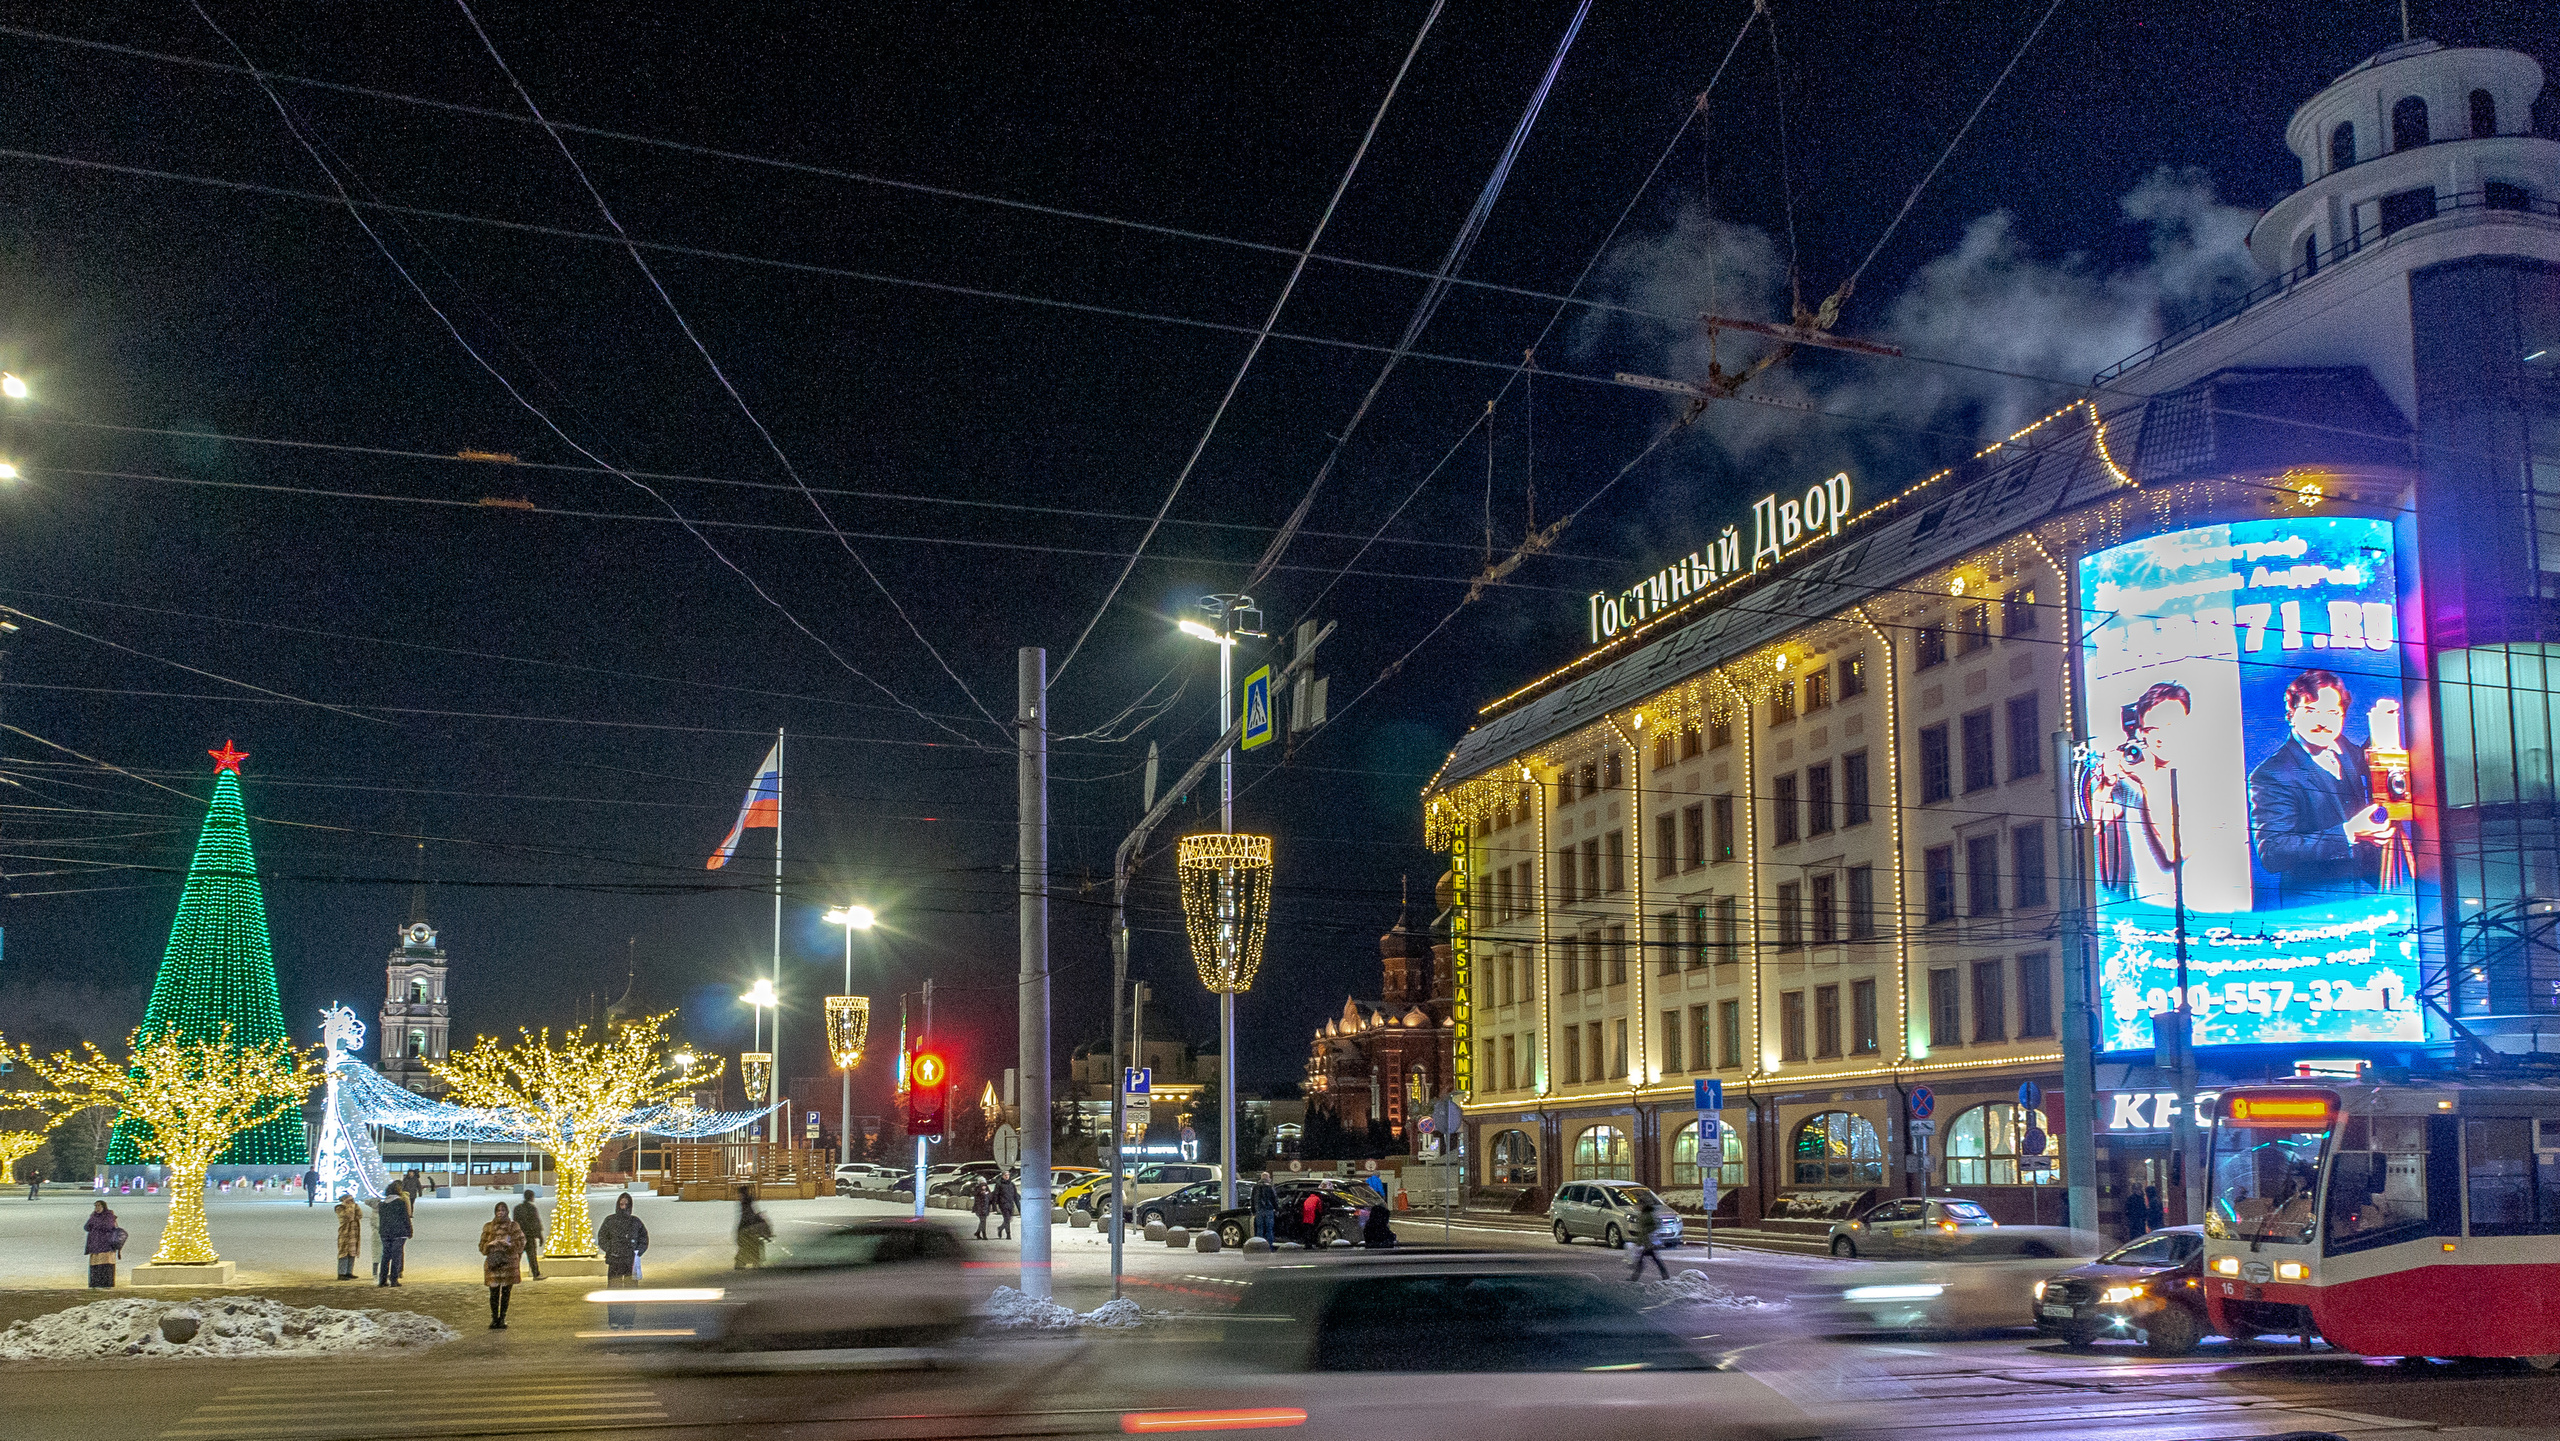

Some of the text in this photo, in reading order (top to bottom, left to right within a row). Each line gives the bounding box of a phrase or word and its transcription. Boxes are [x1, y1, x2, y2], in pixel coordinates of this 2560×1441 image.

[1588, 471, 1852, 643] Гостиный Двор
[1453, 823, 1468, 1091] HOTEL RESTAURANT
[2235, 1099, 2247, 1119] 9
[2221, 1282, 2234, 1295] 16
